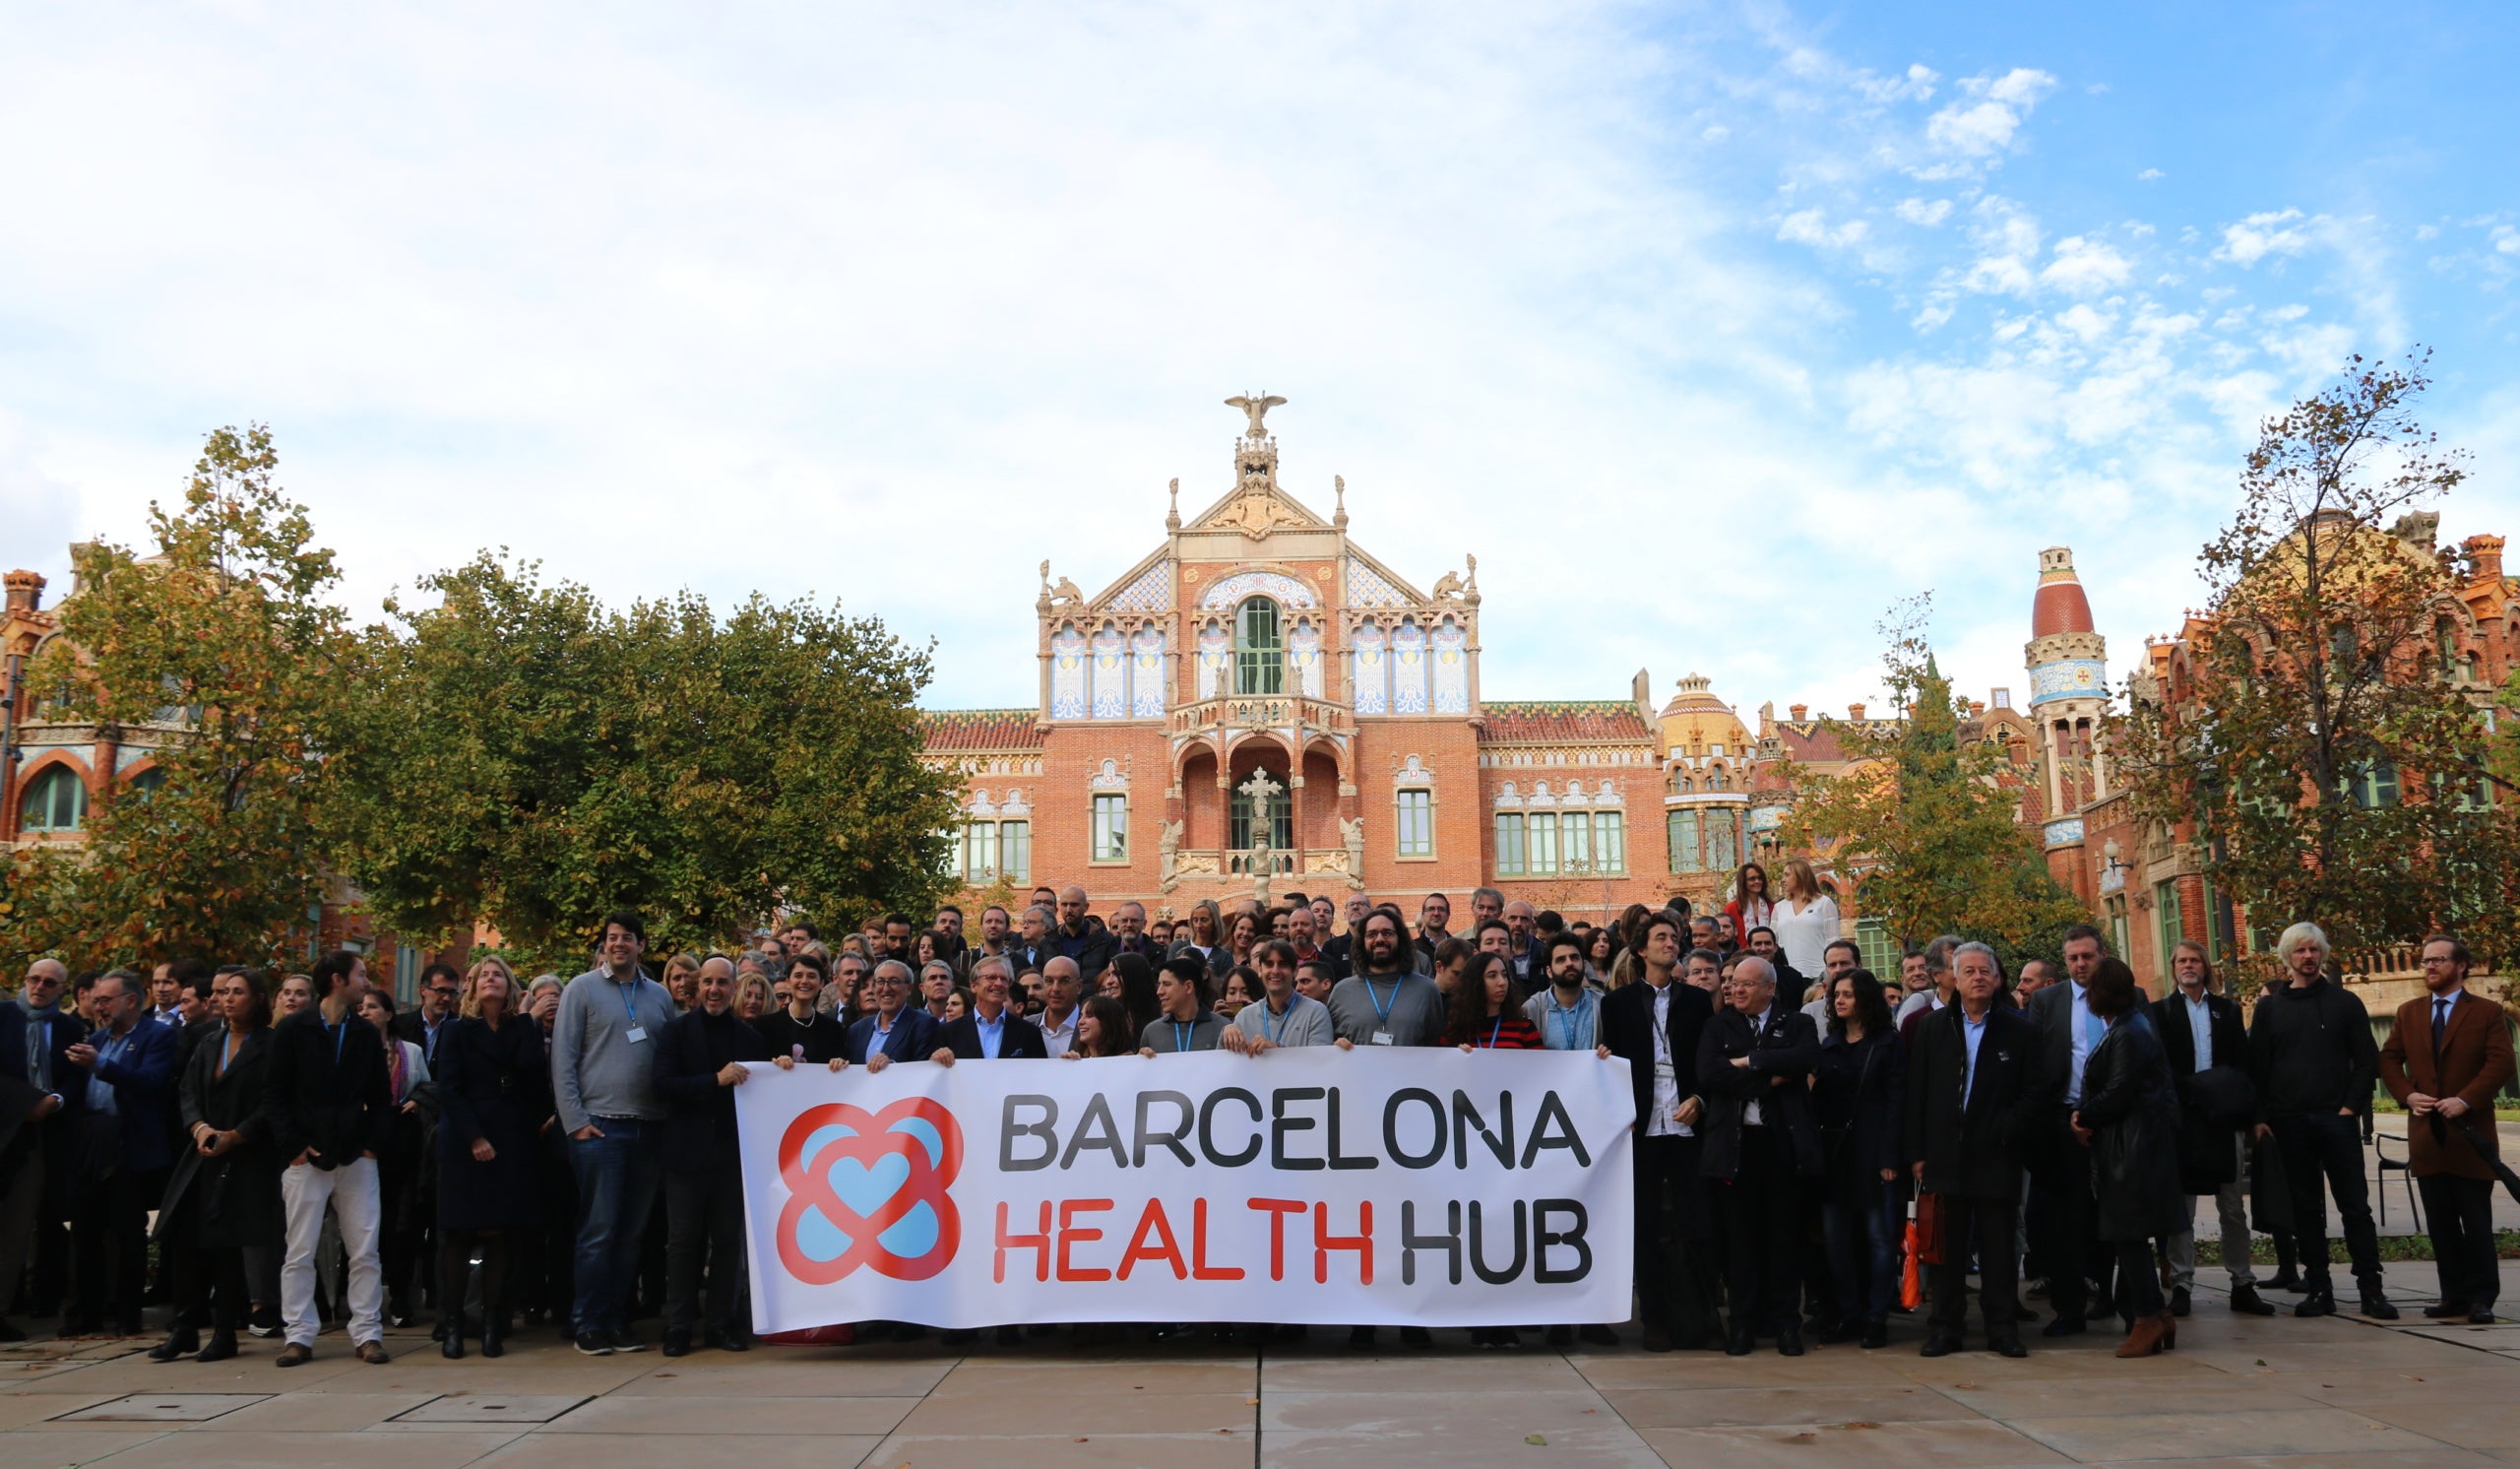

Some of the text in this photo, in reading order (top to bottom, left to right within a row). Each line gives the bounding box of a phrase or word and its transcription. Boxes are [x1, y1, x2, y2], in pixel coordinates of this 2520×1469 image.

[999, 1086, 1592, 1172] BARCELONA
[993, 1197, 1593, 1286] HEALTH HUB
